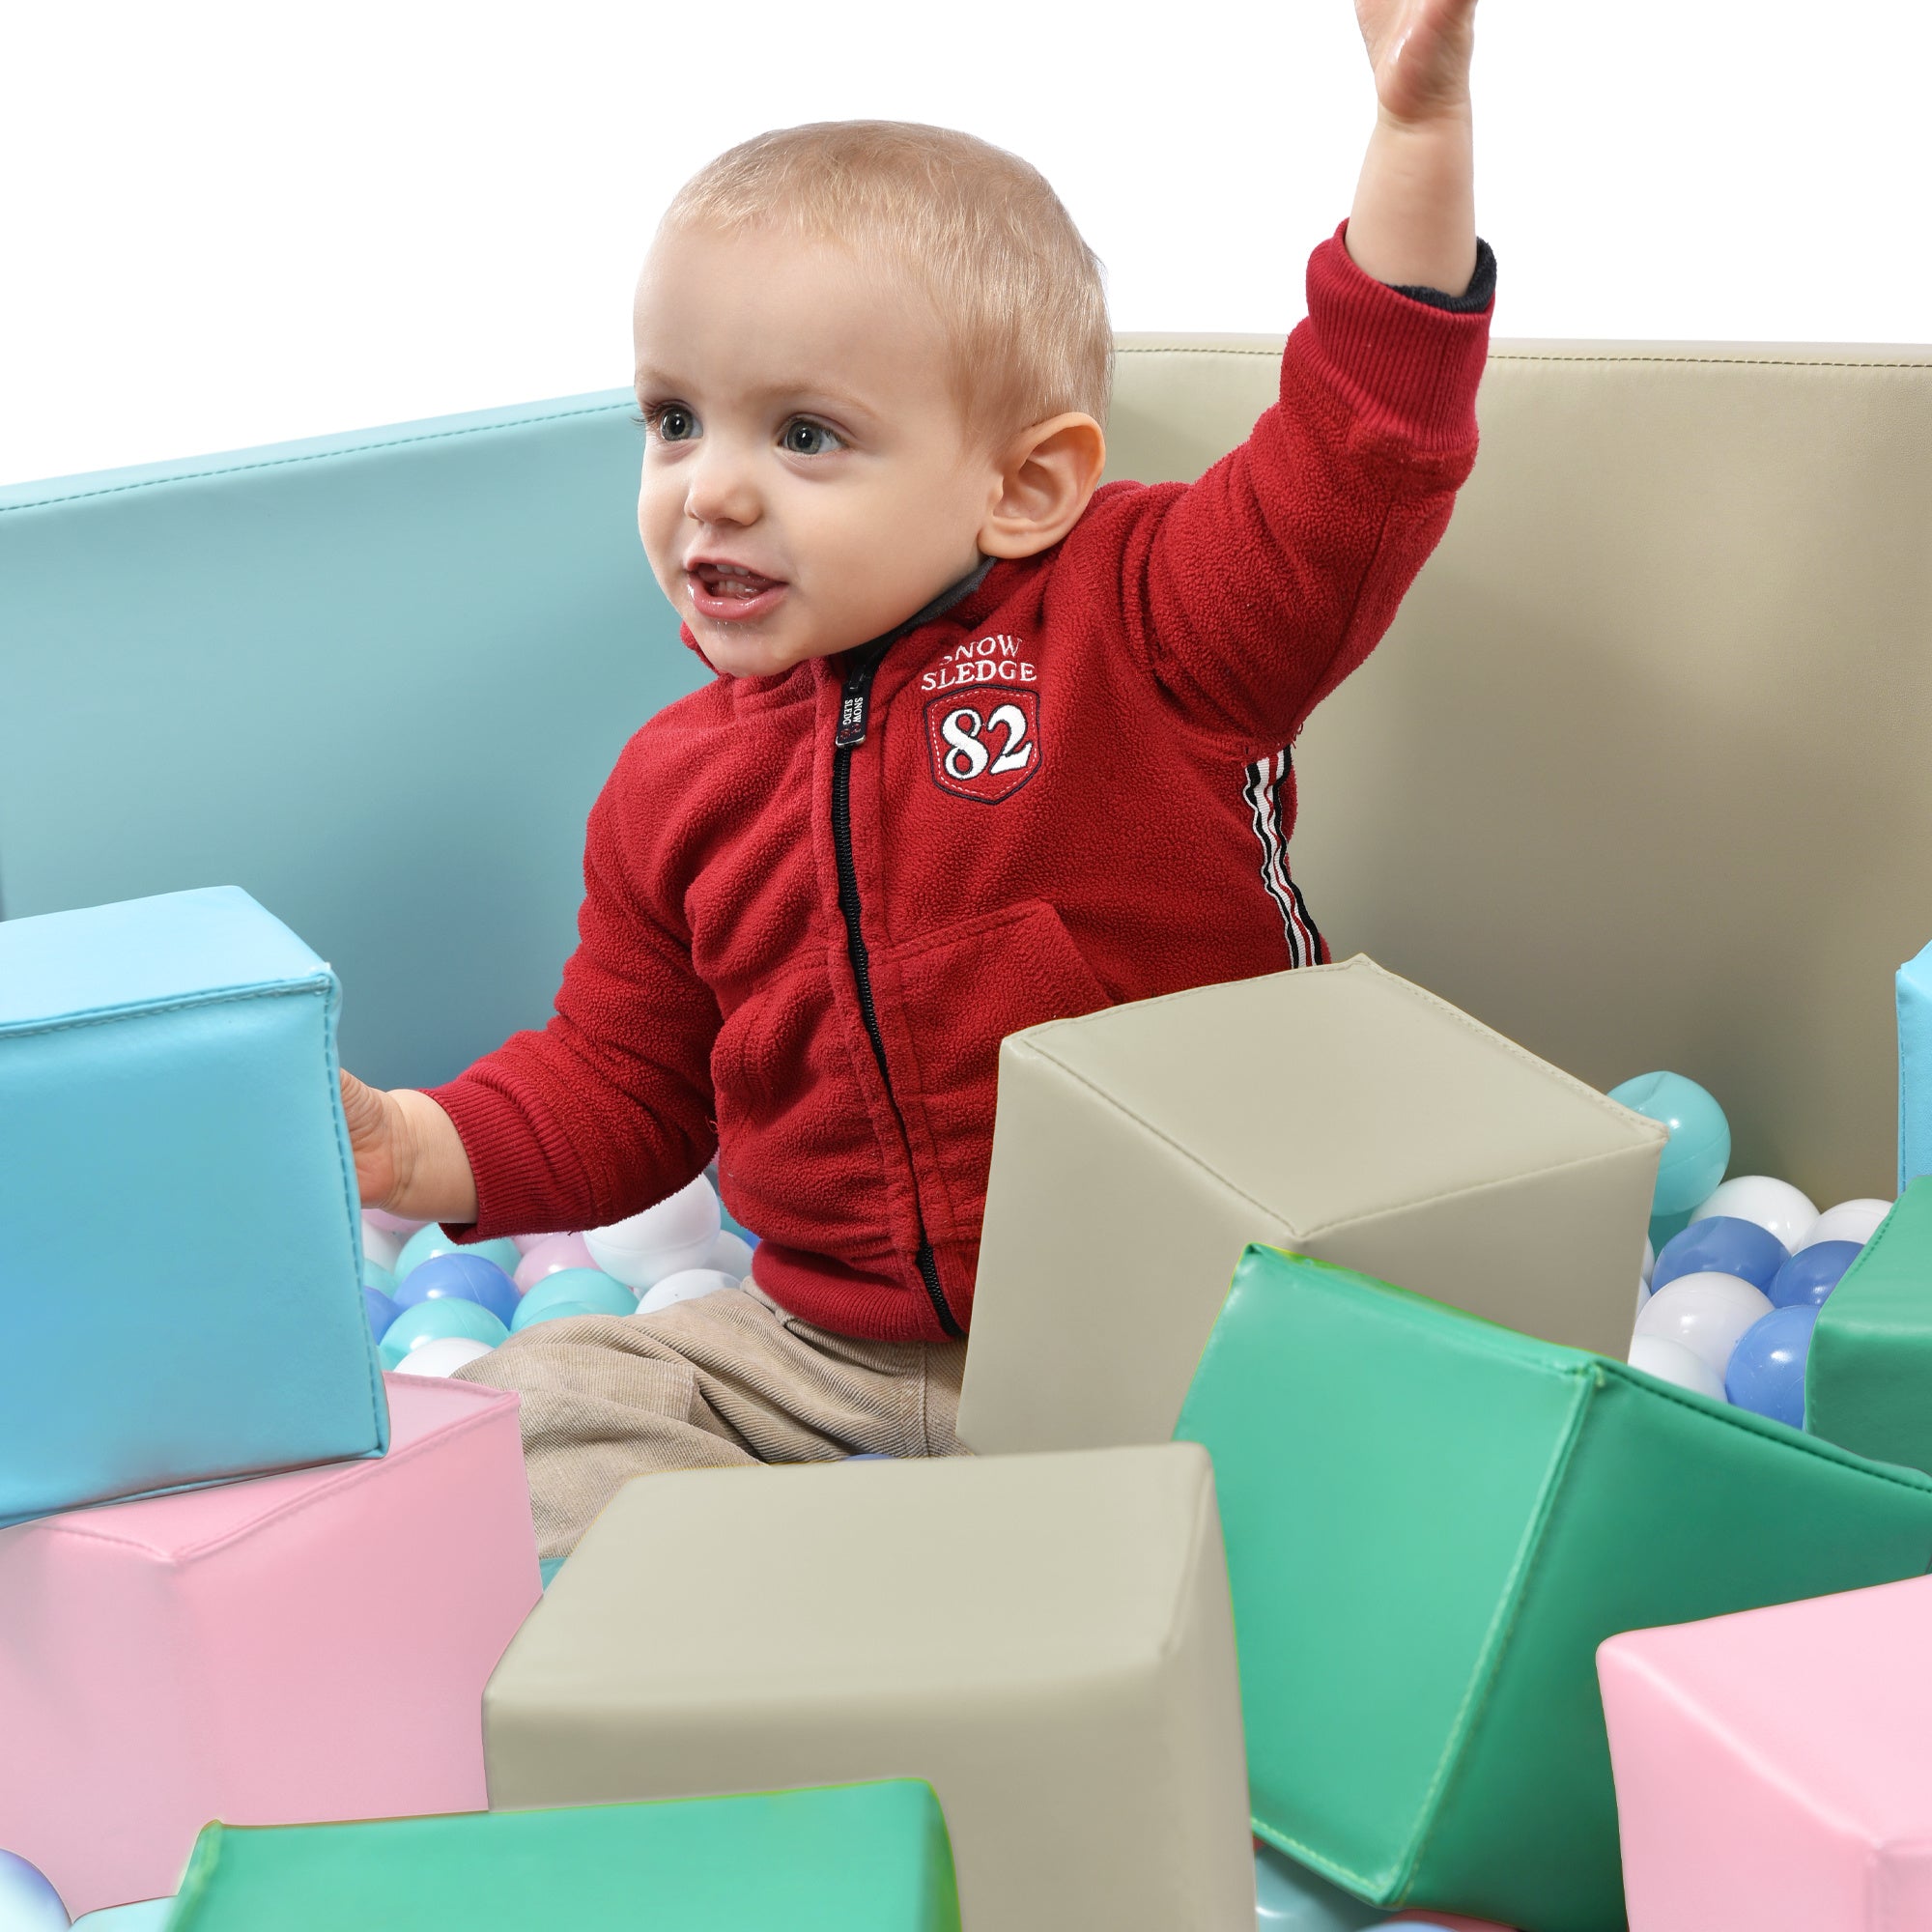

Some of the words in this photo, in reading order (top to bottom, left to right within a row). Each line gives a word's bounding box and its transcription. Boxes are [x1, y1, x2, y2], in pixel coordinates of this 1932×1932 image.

[922, 660, 1037, 690] SLEDGE
[852, 696, 864, 723] SNOW
[941, 703, 1033, 781] 82
